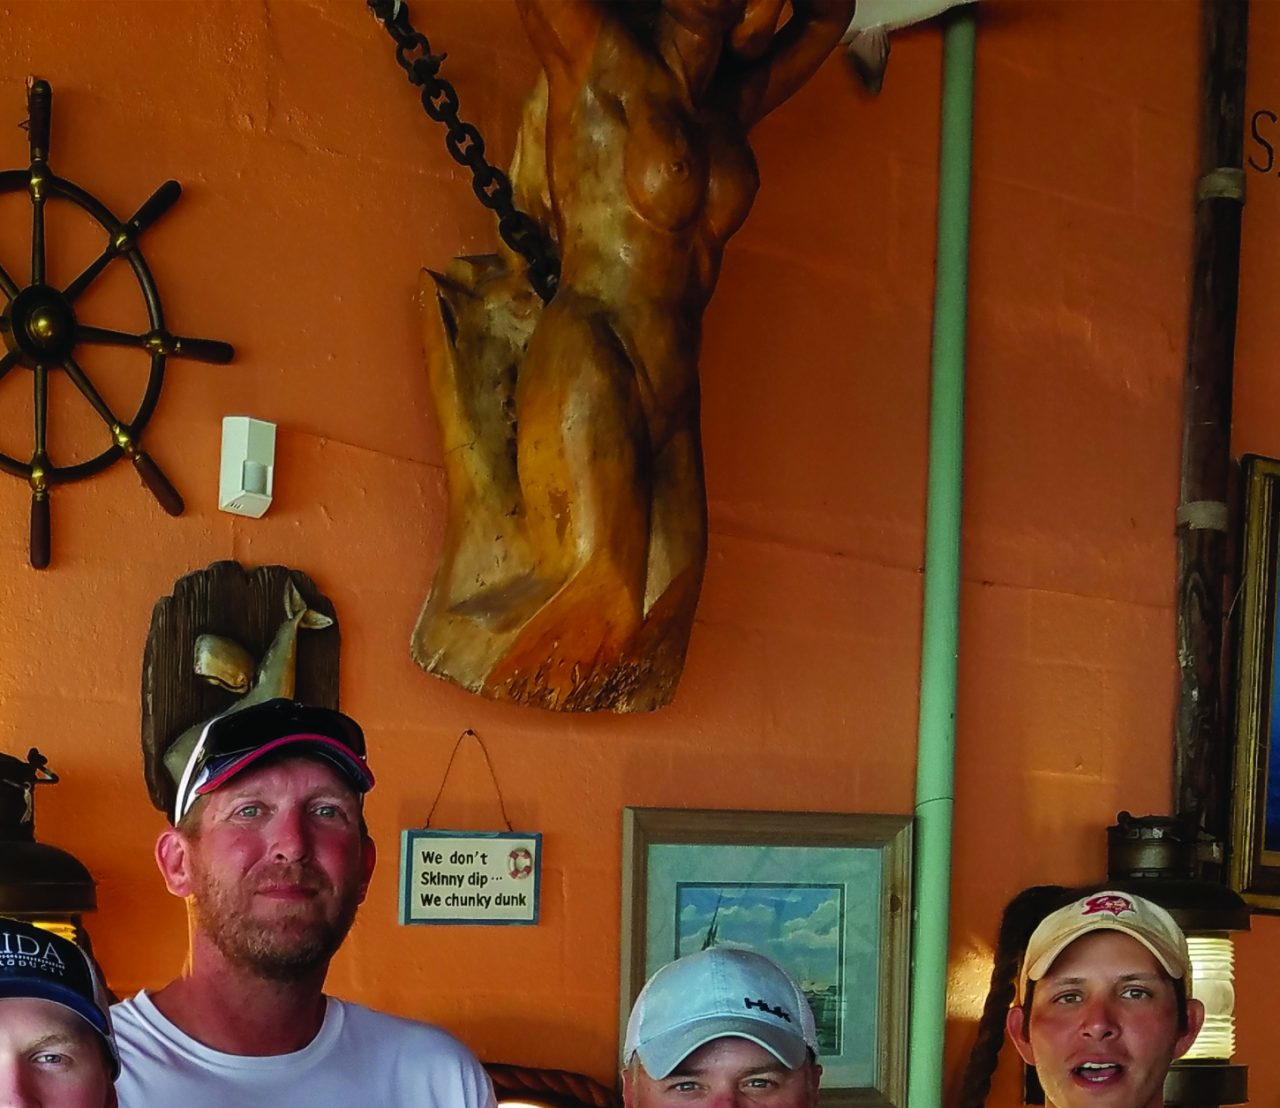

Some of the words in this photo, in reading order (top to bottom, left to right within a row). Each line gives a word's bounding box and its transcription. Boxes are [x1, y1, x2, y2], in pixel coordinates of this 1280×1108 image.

[422, 851, 442, 864] We
[450, 851, 488, 865] don't
[420, 872, 464, 888] Skinny
[420, 894, 442, 906] We
[445, 893, 492, 909] chunky
[494, 893, 526, 906] dunk
